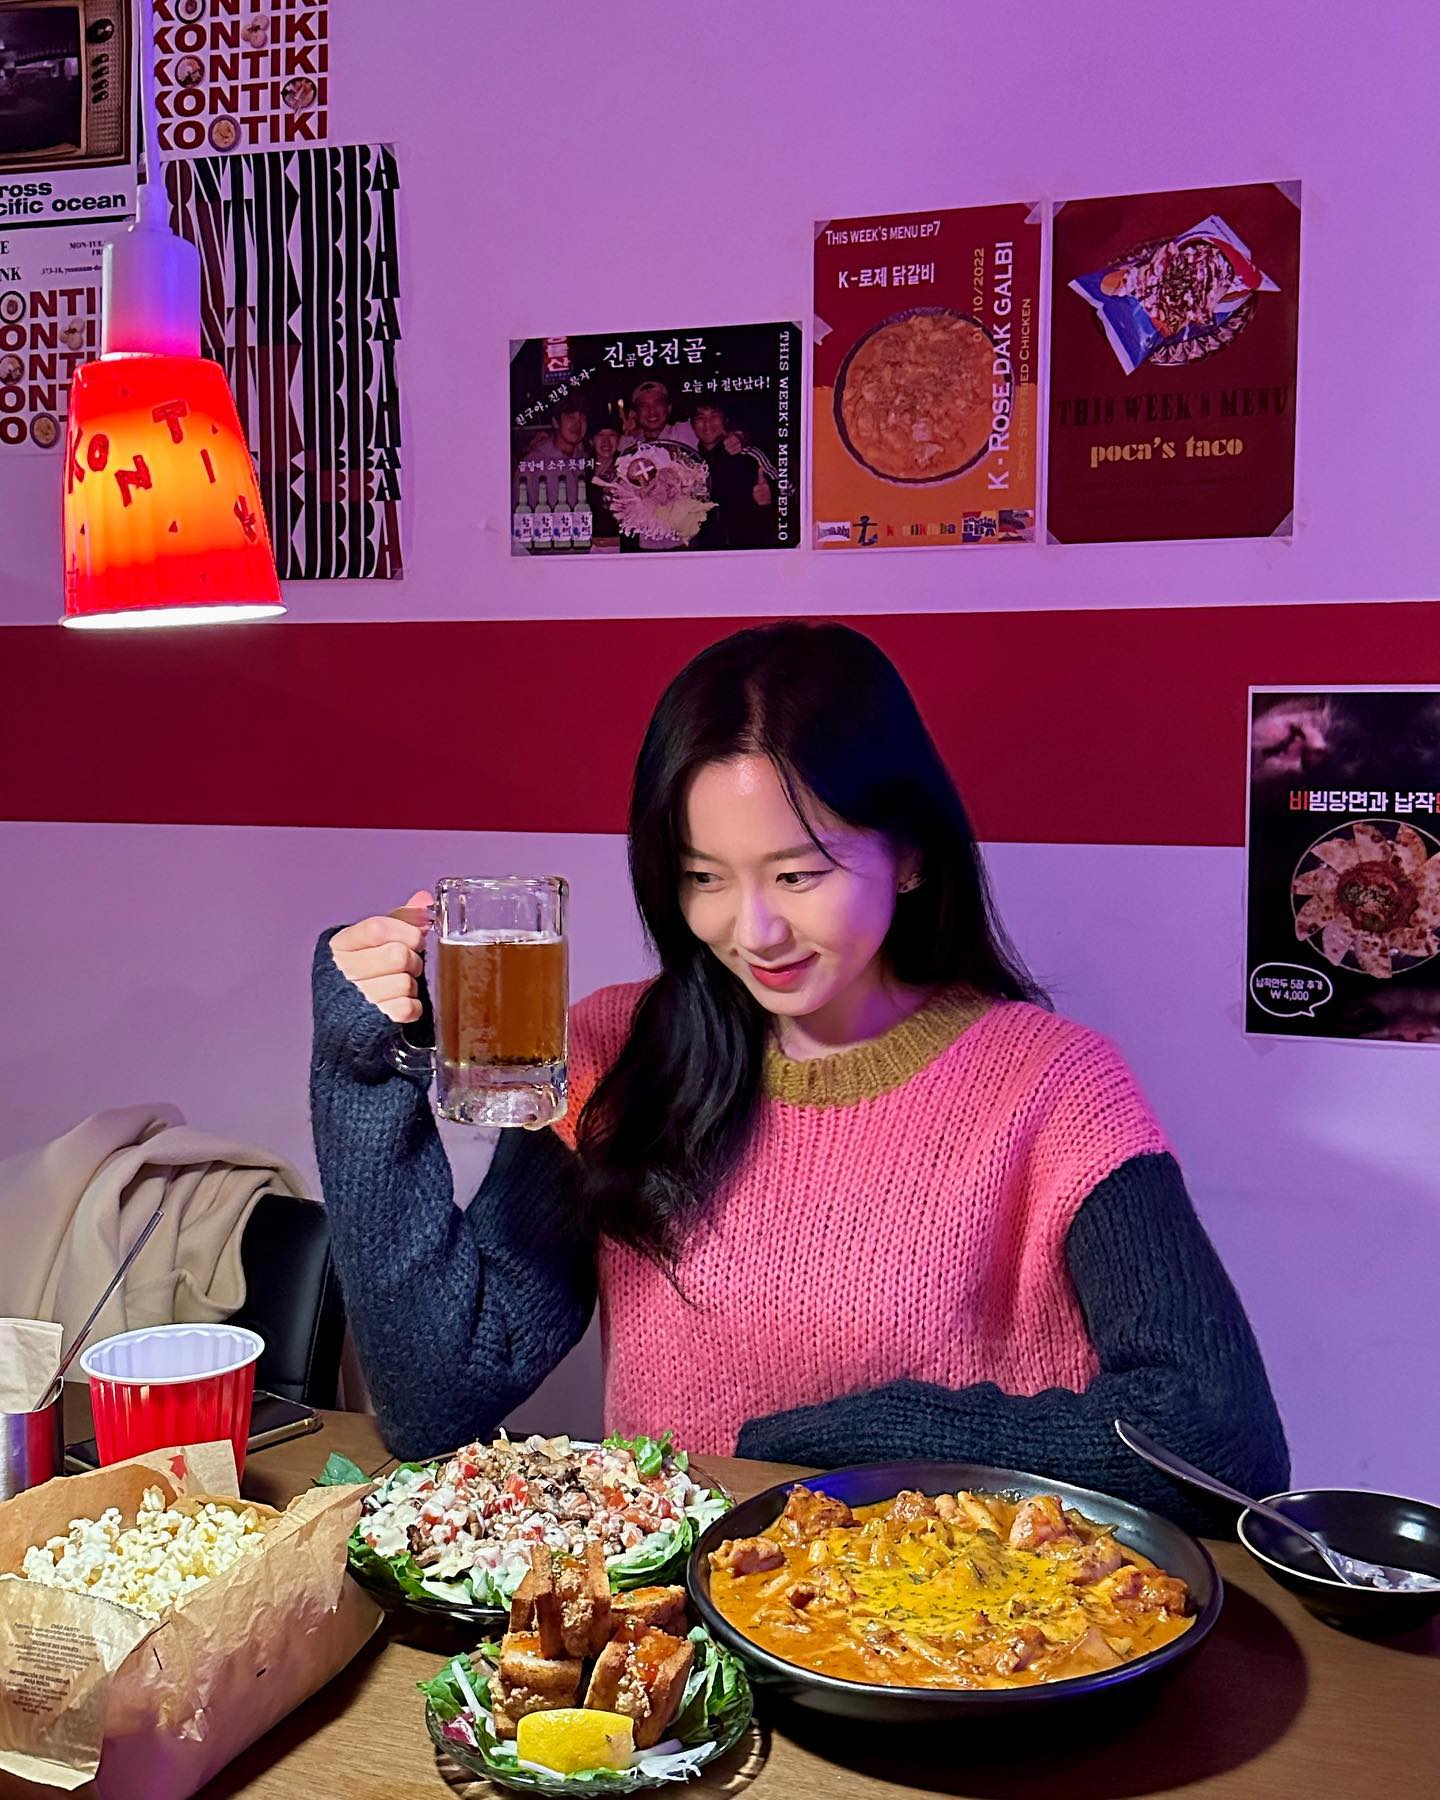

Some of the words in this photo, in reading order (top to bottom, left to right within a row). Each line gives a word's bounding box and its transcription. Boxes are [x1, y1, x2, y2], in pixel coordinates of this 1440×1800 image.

[0, 183, 52, 198] ross
[52, 194, 126, 212] ocean
[825, 230, 848, 246] THIS
[850, 226, 888, 243] WEEK'S
[889, 225, 919, 240] MENU
[920, 220, 941, 238] EP7
[892, 262, 935, 287] 닭갈비
[993, 241, 1013, 316] GALBI
[1019, 298, 1031, 361] CHICKEN
[779, 331, 790, 372] THIS
[992, 323, 1012, 375] DAK
[681, 379, 703, 393] 오늘
[707, 378, 718, 393] 마
[778, 376, 790, 438] WEEK'S
[988, 381, 1011, 452] ROSE
[1057, 398, 1114, 427] THIS
[1123, 391, 1211, 423] WEEK'S
[1218, 386, 1289, 418] MENU
[547, 459, 566, 471] 소주
[778, 444, 789, 489] MENU
[1090, 436, 1177, 468] poca's
[1185, 436, 1244, 458] taco
[988, 471, 1009, 491] K
[1290, 790, 1389, 812] 비빔당면과
[1283, 990, 1309, 1001] 4,000
